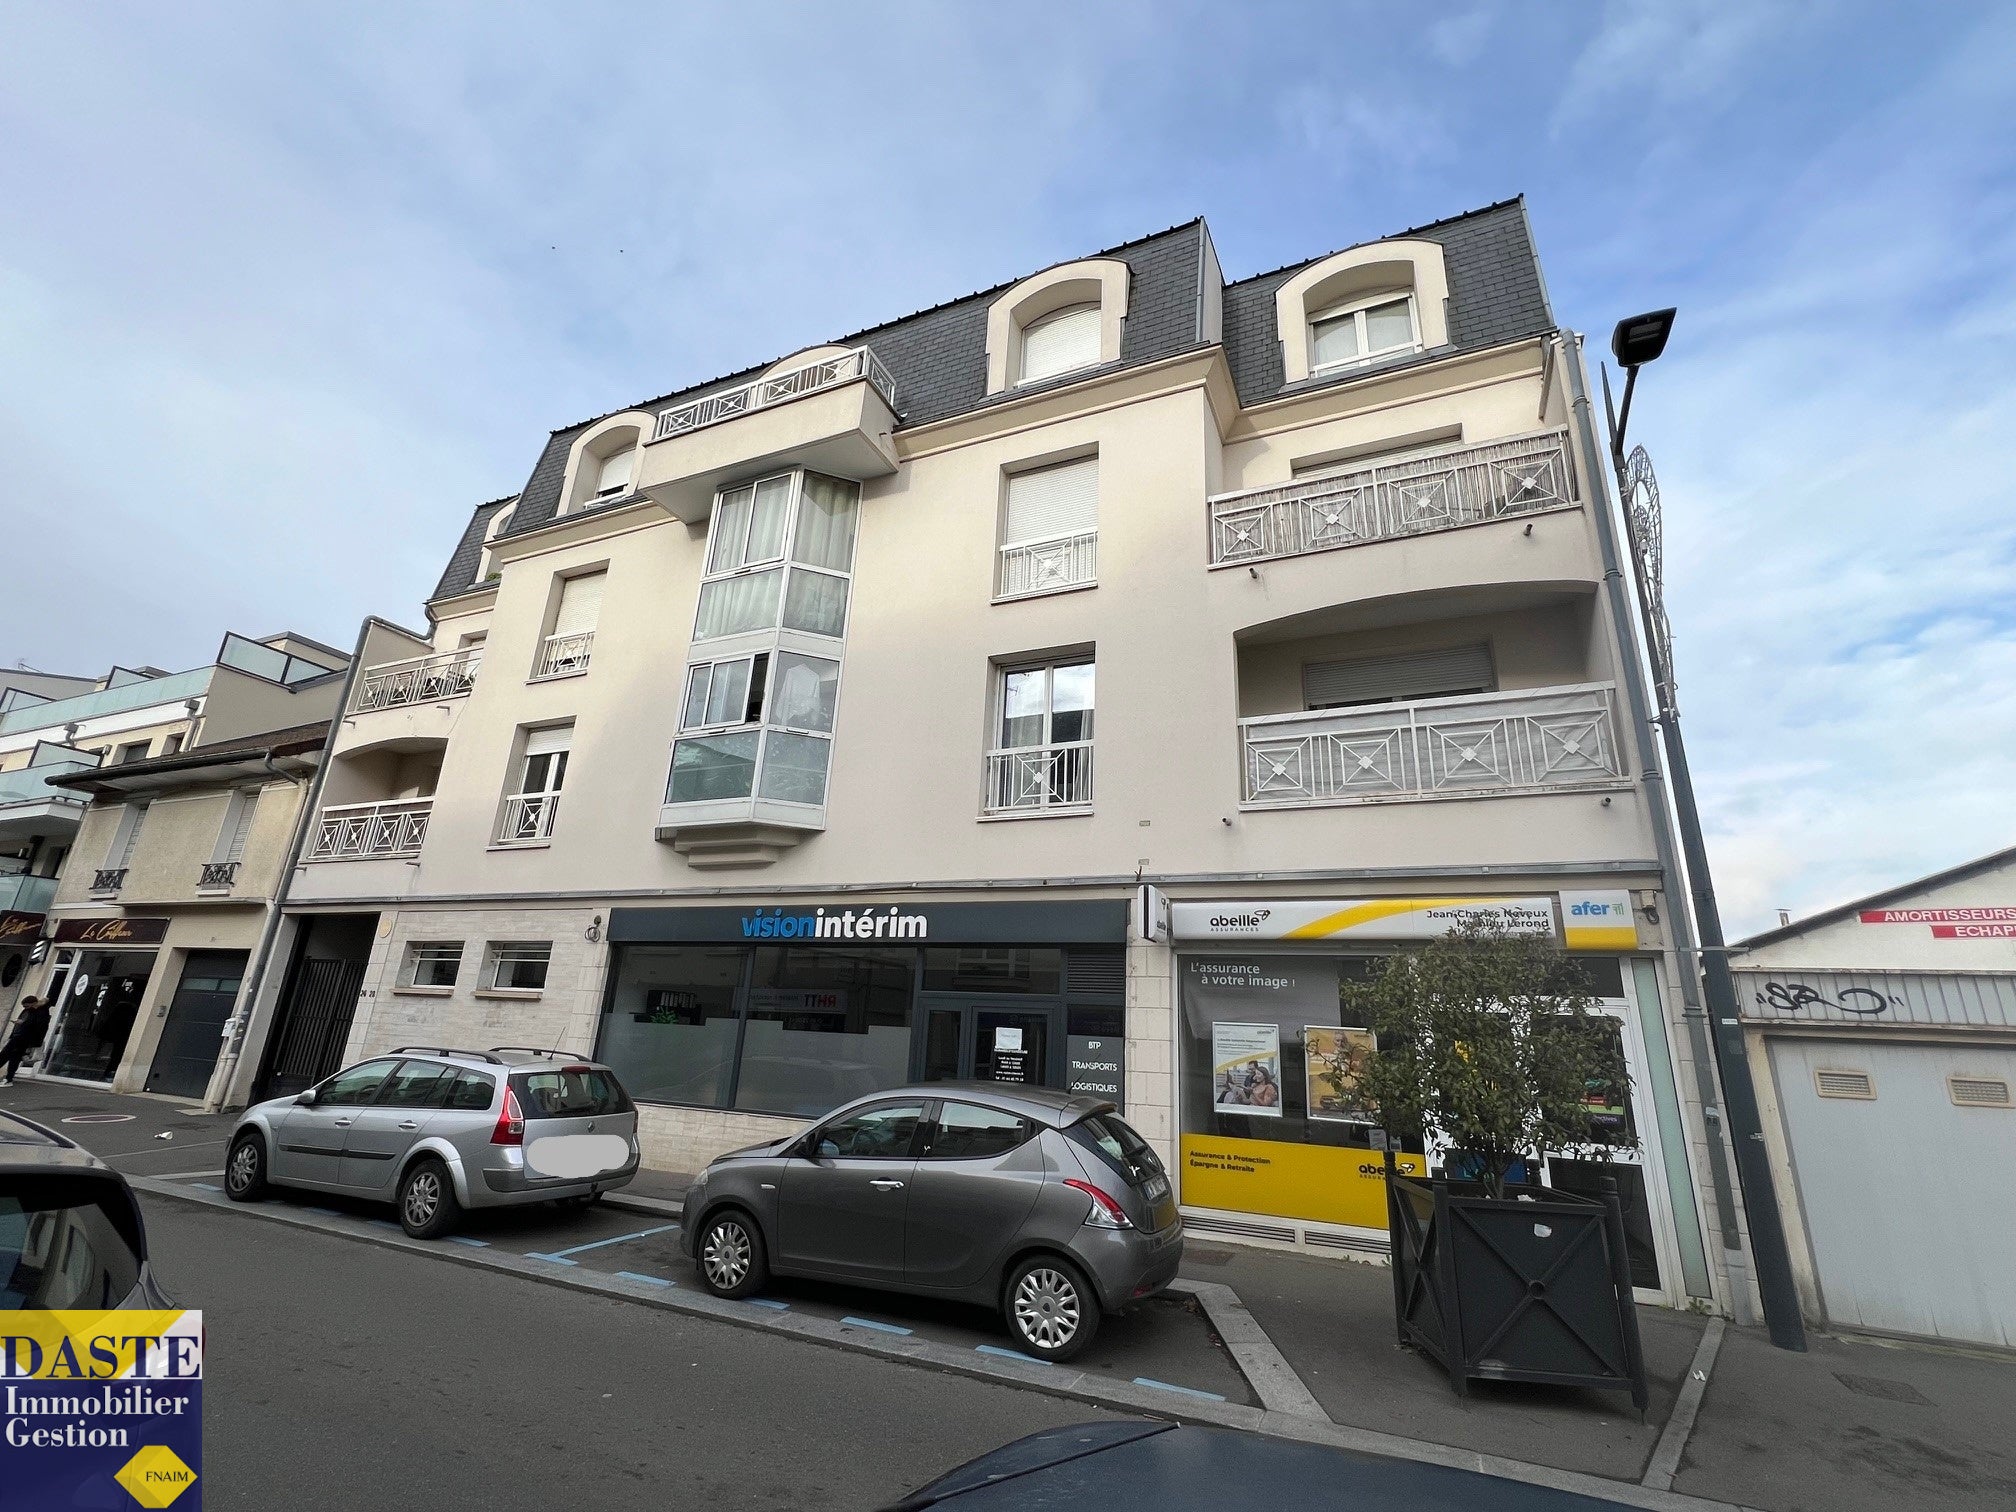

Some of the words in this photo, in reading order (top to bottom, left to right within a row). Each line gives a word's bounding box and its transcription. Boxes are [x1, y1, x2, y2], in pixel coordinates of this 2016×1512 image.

[1571, 901, 1610, 915] afer
[1210, 915, 1260, 926] abeille
[1884, 908, 2016, 922] AMORTISSEURS
[1955, 925, 2016, 937] ECHAP
[1190, 962, 1260, 973] L'assurance
[1201, 975, 1208, 985] à
[1212, 976, 1245, 986] votre
[1249, 974, 1288, 989] image
[1088, 1041, 1101, 1050] BTP
[1072, 1061, 1118, 1072] TRANSPORTS
[1071, 1081, 1118, 1093] LOGISTIQUES
[1190, 1150, 1225, 1160] Assurance
[1233, 1155, 1271, 1164] Protection
[1227, 1164, 1255, 1172] Retraite
